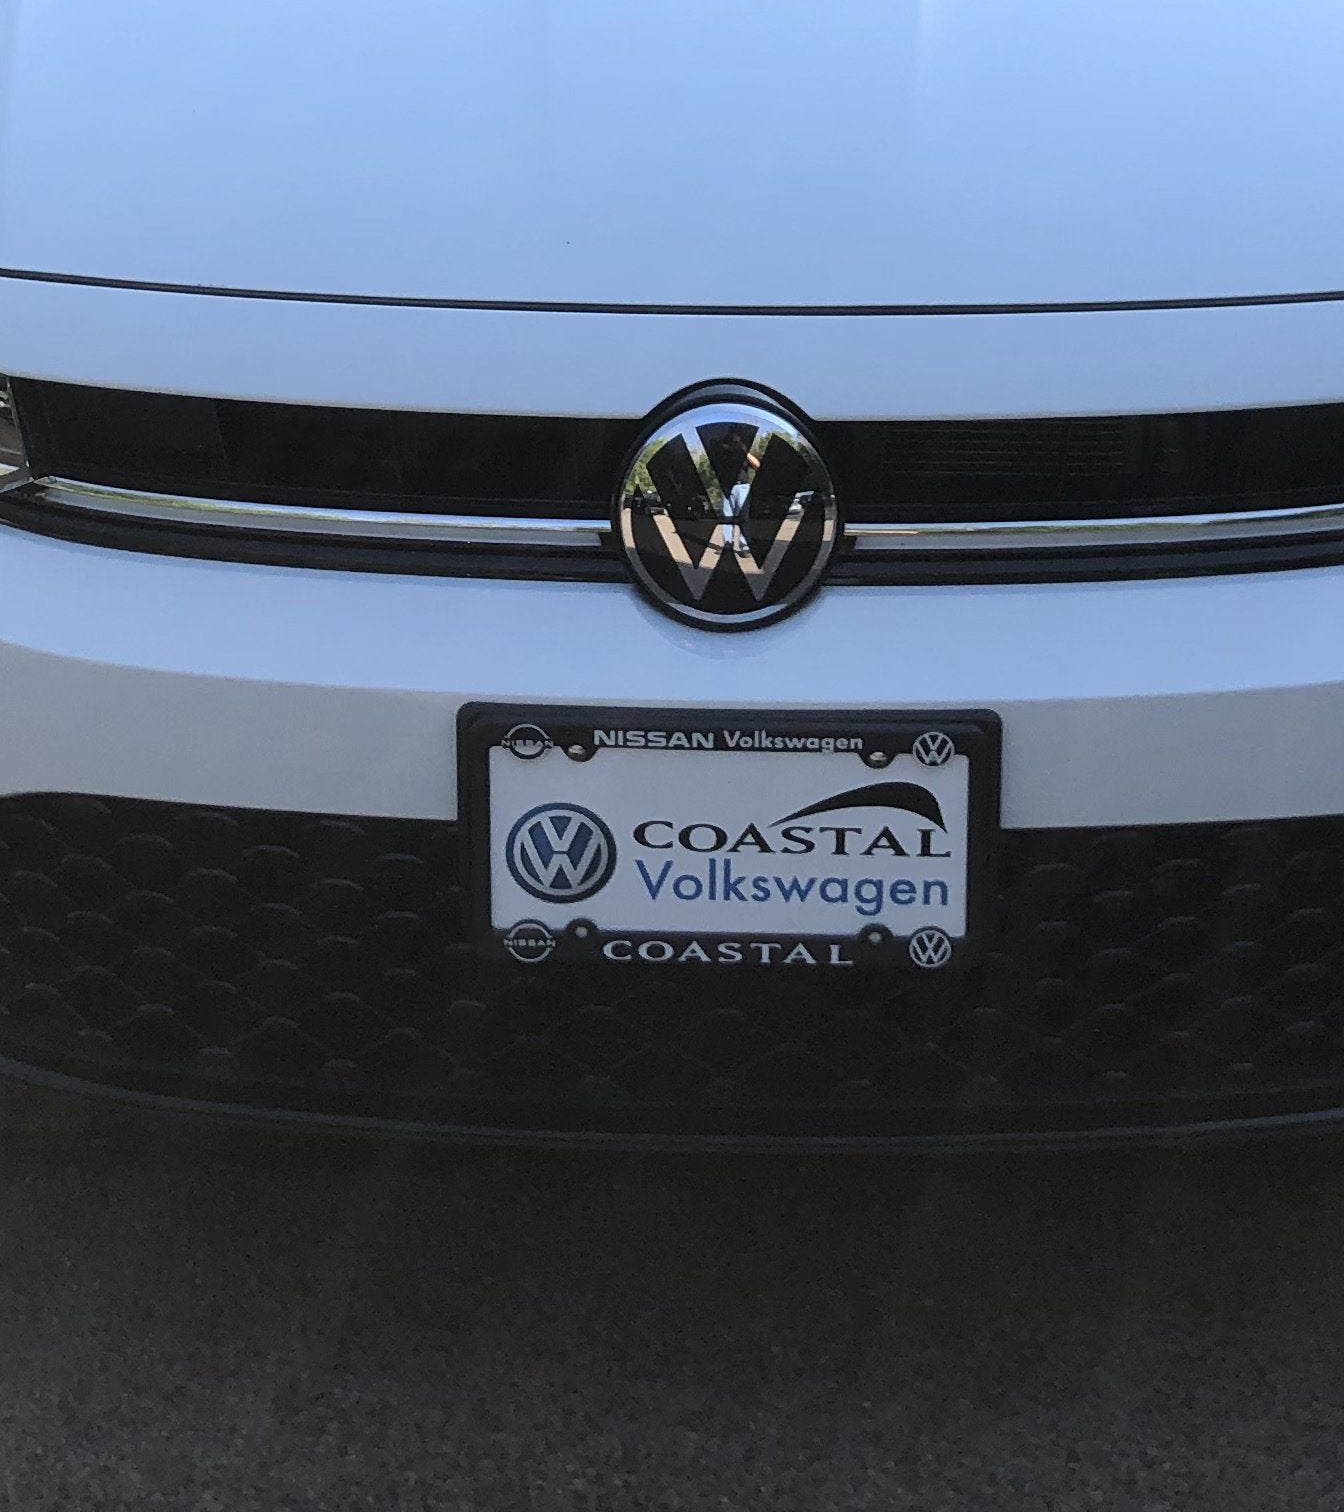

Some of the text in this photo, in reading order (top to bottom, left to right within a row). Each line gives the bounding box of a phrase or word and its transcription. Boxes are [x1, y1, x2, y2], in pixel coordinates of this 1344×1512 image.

[593, 729, 863, 753] NISSAN Volkswagen
[633, 820, 952, 858] COASTAL
[635, 858, 950, 916] Volkswagen
[602, 940, 854, 966] COASTAL
